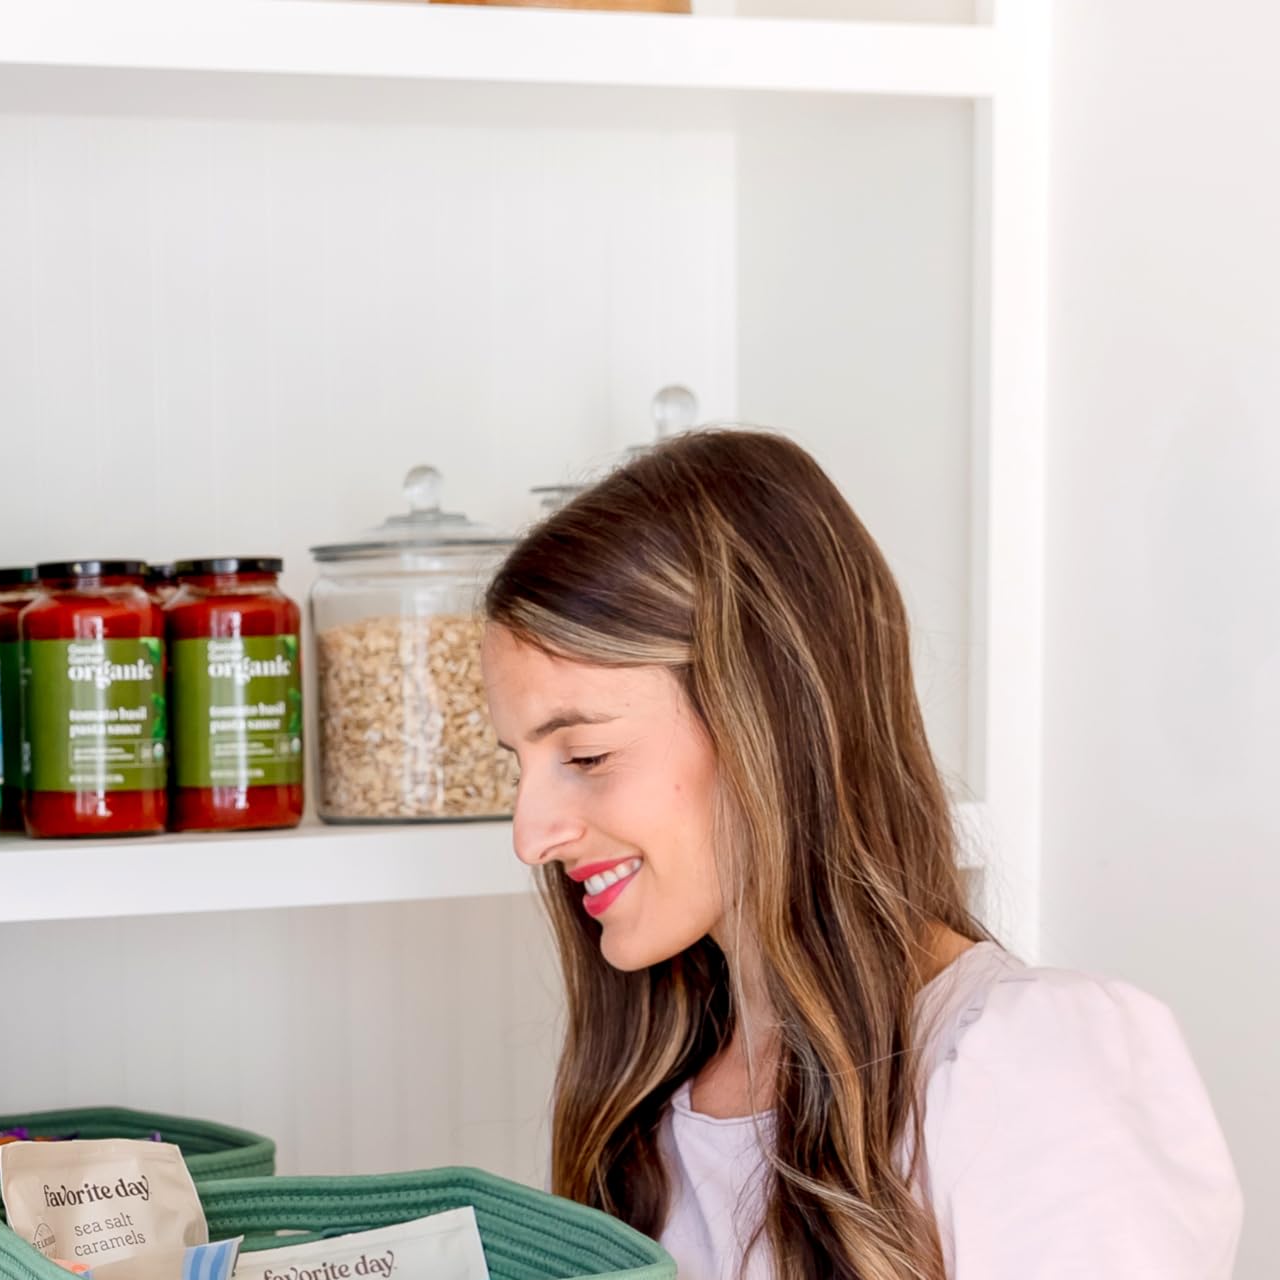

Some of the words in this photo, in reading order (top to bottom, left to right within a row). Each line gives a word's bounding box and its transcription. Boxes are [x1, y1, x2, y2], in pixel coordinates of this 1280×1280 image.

[68, 659, 153, 689] organic
[208, 655, 291, 685] organic
[43, 1183, 113, 1208] favorite
[115, 1175, 150, 1200] day
[74, 1220, 103, 1237] sea
[105, 1212, 134, 1230] salt
[74, 1229, 146, 1257] caramels
[354, 1250, 395, 1278] day
